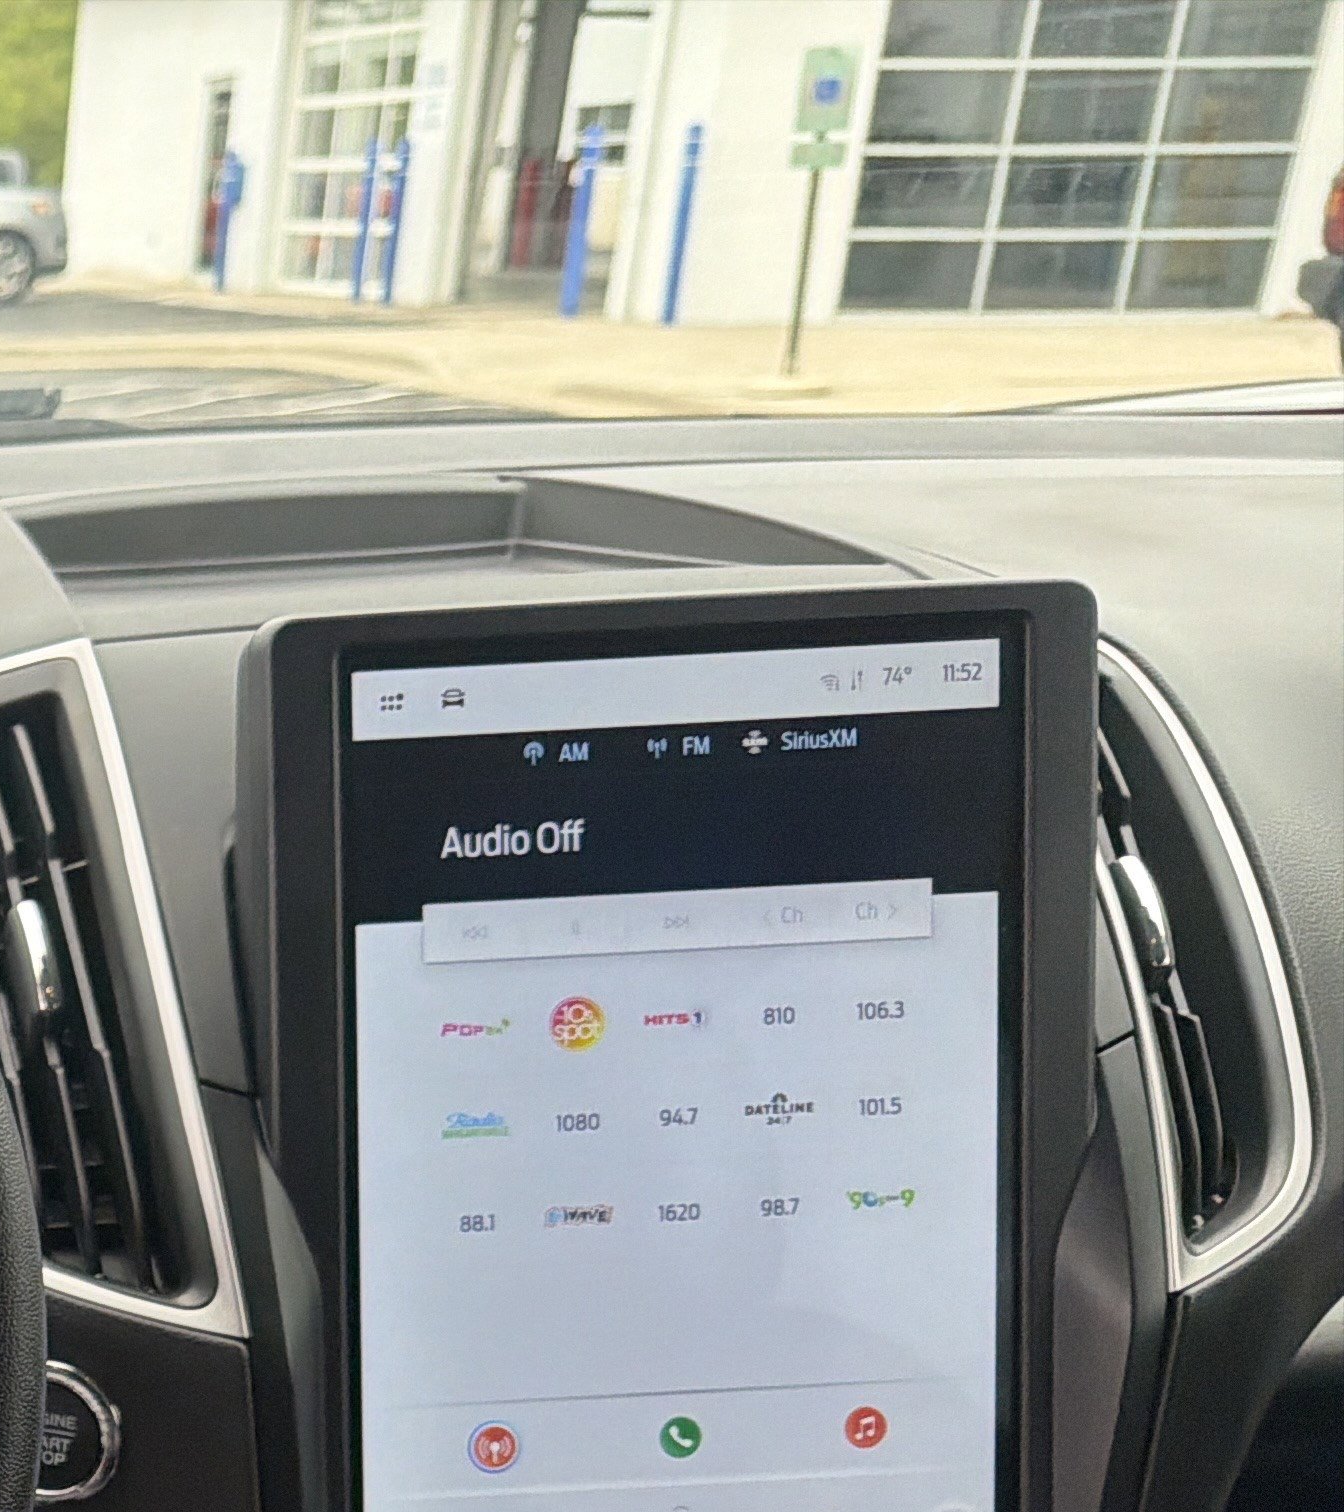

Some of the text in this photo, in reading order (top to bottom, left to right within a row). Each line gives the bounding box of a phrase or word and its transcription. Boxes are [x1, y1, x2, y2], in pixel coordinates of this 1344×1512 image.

[882, 665, 913, 686] 74°
[942, 662, 983, 684] 11:52
[681, 734, 711, 756] FM
[780, 727, 858, 752] SiriusXM
[558, 741, 590, 762] AM
[440, 818, 585, 859] Audio Off
[643, 1011, 689, 1026] HITS
[762, 1006, 795, 1026] 810
[856, 1000, 906, 1021] 106.3
[658, 1106, 699, 1127] 94.7
[743, 1100, 815, 1117] DATELINE
[858, 1096, 903, 1116] 101.5
[555, 1112, 601, 1133] 1080
[658, 1202, 701, 1223] 1620
[760, 1196, 800, 1218] 98.7
[459, 1213, 496, 1234] 88.1
